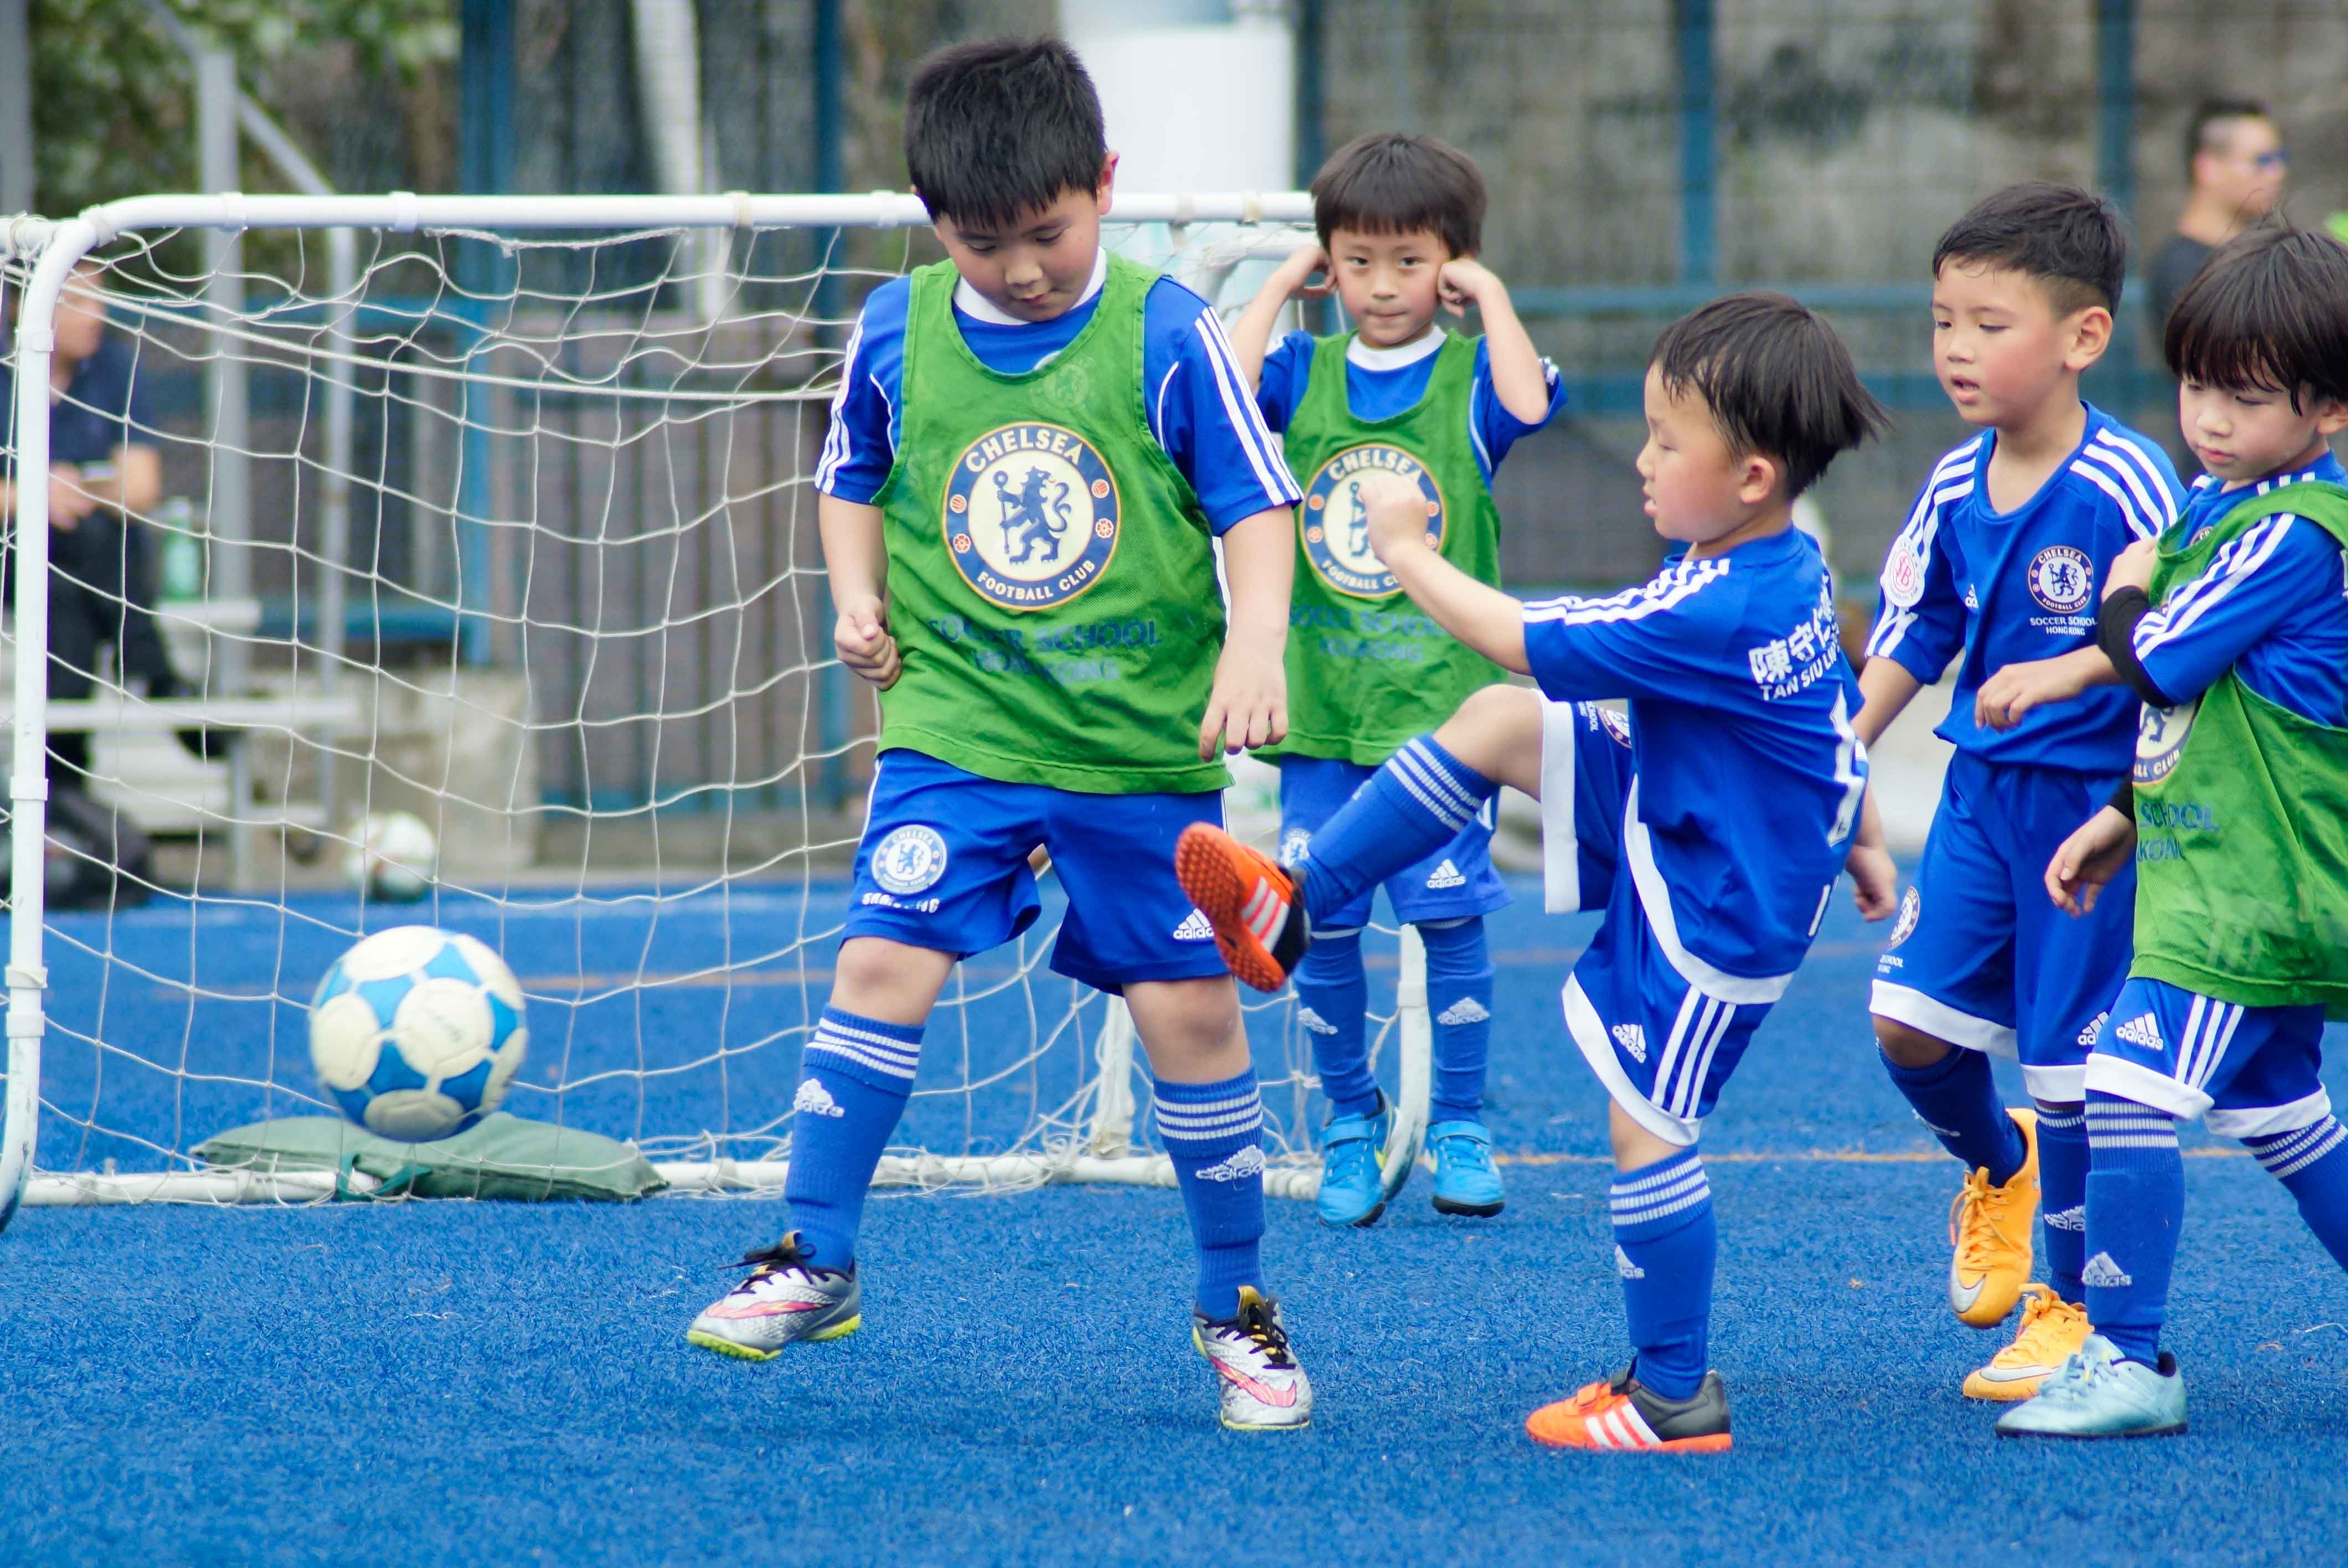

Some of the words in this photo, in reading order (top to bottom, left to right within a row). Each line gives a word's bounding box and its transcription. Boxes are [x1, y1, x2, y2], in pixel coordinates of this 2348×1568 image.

[965, 427, 1084, 473] CHELSEA
[2038, 548, 2082, 563] CHELSEA
[977, 571, 1054, 600] FOOTBALL
[1059, 560, 1095, 591] CLUB
[1321, 560, 1379, 590] FOOTBALL
[2042, 597, 2073, 610] FOOTBALL
[2074, 596, 2087, 608] CLUB
[1035, 620, 1162, 652] SCHOOL
[2030, 616, 2067, 626] SOCCER
[2068, 616, 2097, 626] SCHOOL
[2046, 626, 2068, 635] HONG
[2068, 627, 2086, 636] KONG
[1760, 675, 1799, 701] TAN
[1801, 658, 1823, 688] SIU
[2140, 802, 2220, 832] SCHOOL
[1427, 875, 1466, 888] adidas
[1612, 1025, 1646, 1064] adidas
[2116, 1027, 2164, 1050] adidas
